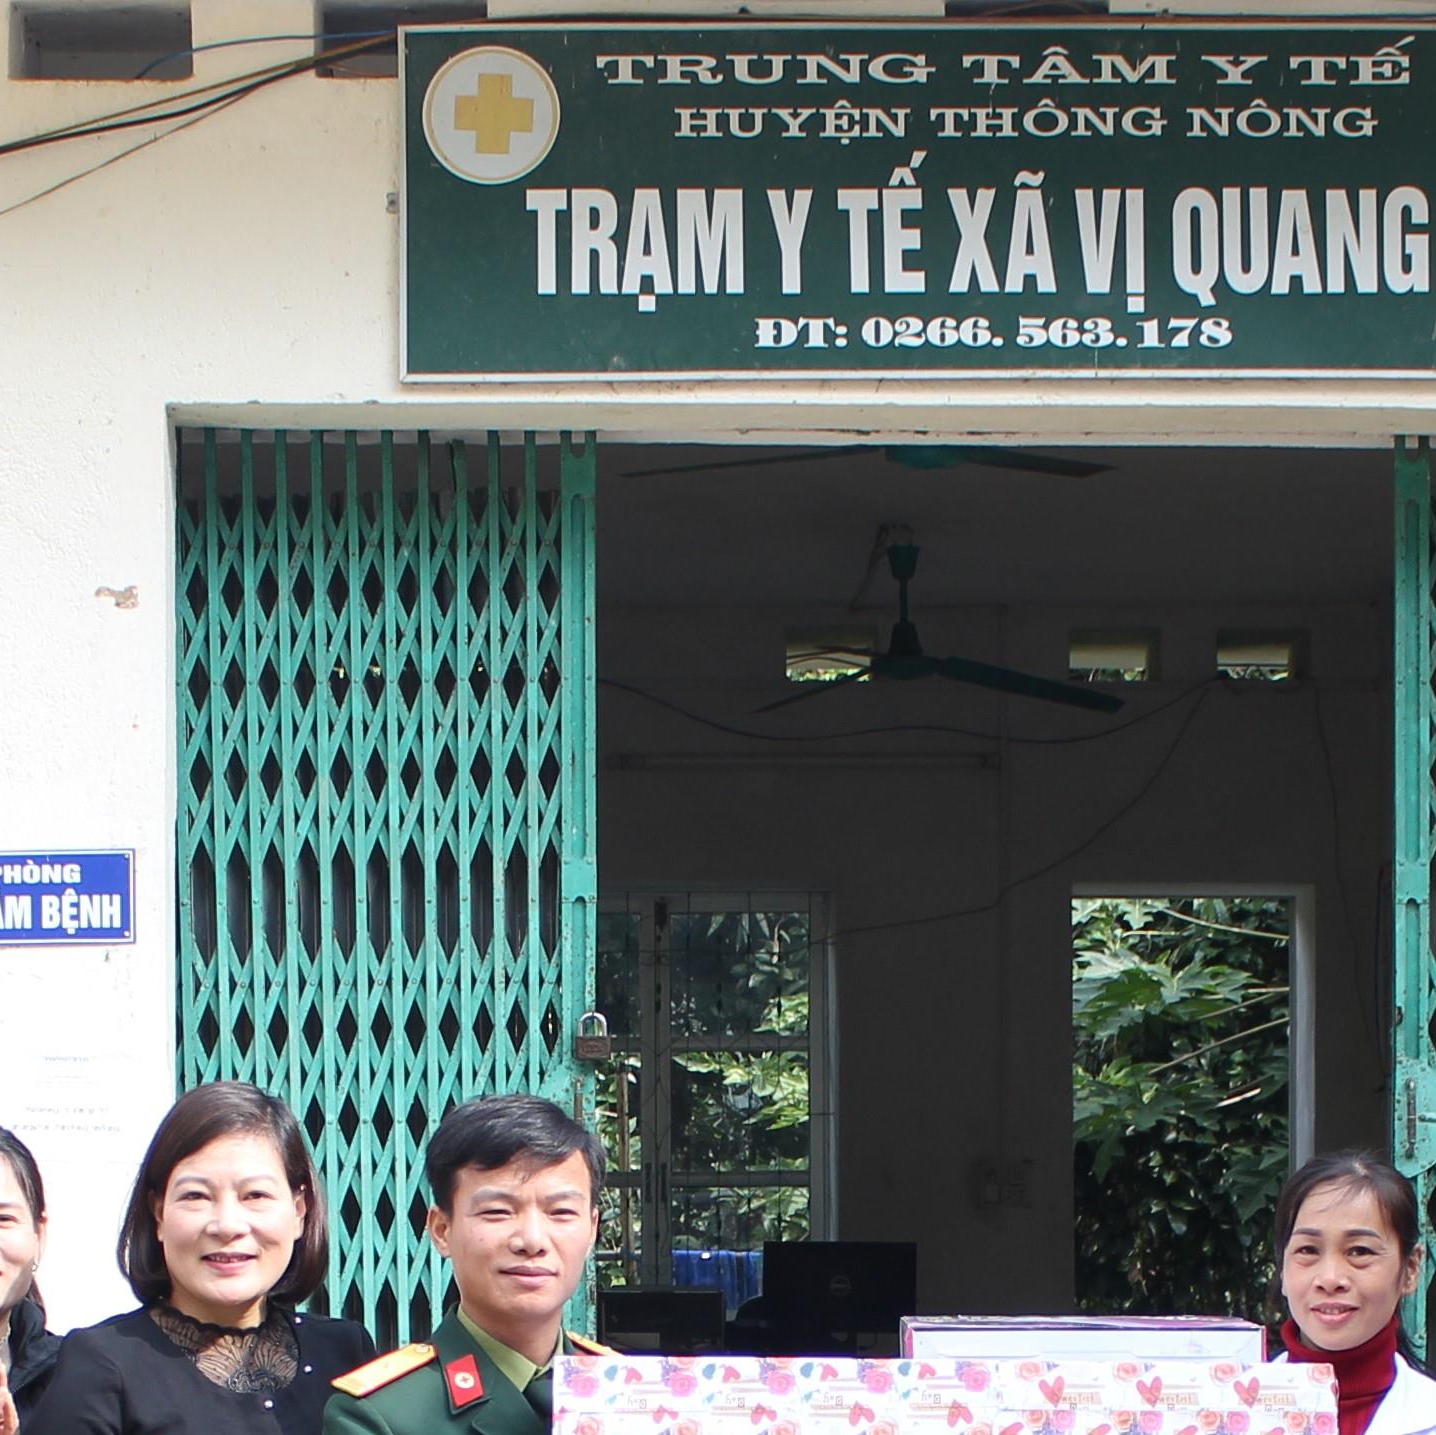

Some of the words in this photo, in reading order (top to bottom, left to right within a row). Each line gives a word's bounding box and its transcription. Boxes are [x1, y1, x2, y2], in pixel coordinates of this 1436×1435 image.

[597, 53, 936, 85] TRUNG
[963, 46, 1177, 86] TÂM
[1202, 54, 1268, 85] Y
[1290, 36, 1415, 85] TẾ
[674, 100, 911, 145] HUYỆN
[930, 98, 1168, 138] THÔNG
[1186, 98, 1379, 138] NÔNG
[526, 188, 745, 313] TRẠM
[766, 188, 814, 295] Y
[837, 150, 927, 295] TẾ
[947, 170, 1058, 295] XÃ
[1078, 188, 1145, 314] VỊ
[1172, 186, 1431, 308] QUANG
[754, 316, 848, 349] ĐT:
[861, 316, 1004, 349] 0266.
[1015, 315, 1128, 349] 563.
[1136, 317, 1233, 349] 178
[41, 887, 123, 934] BỆNH
